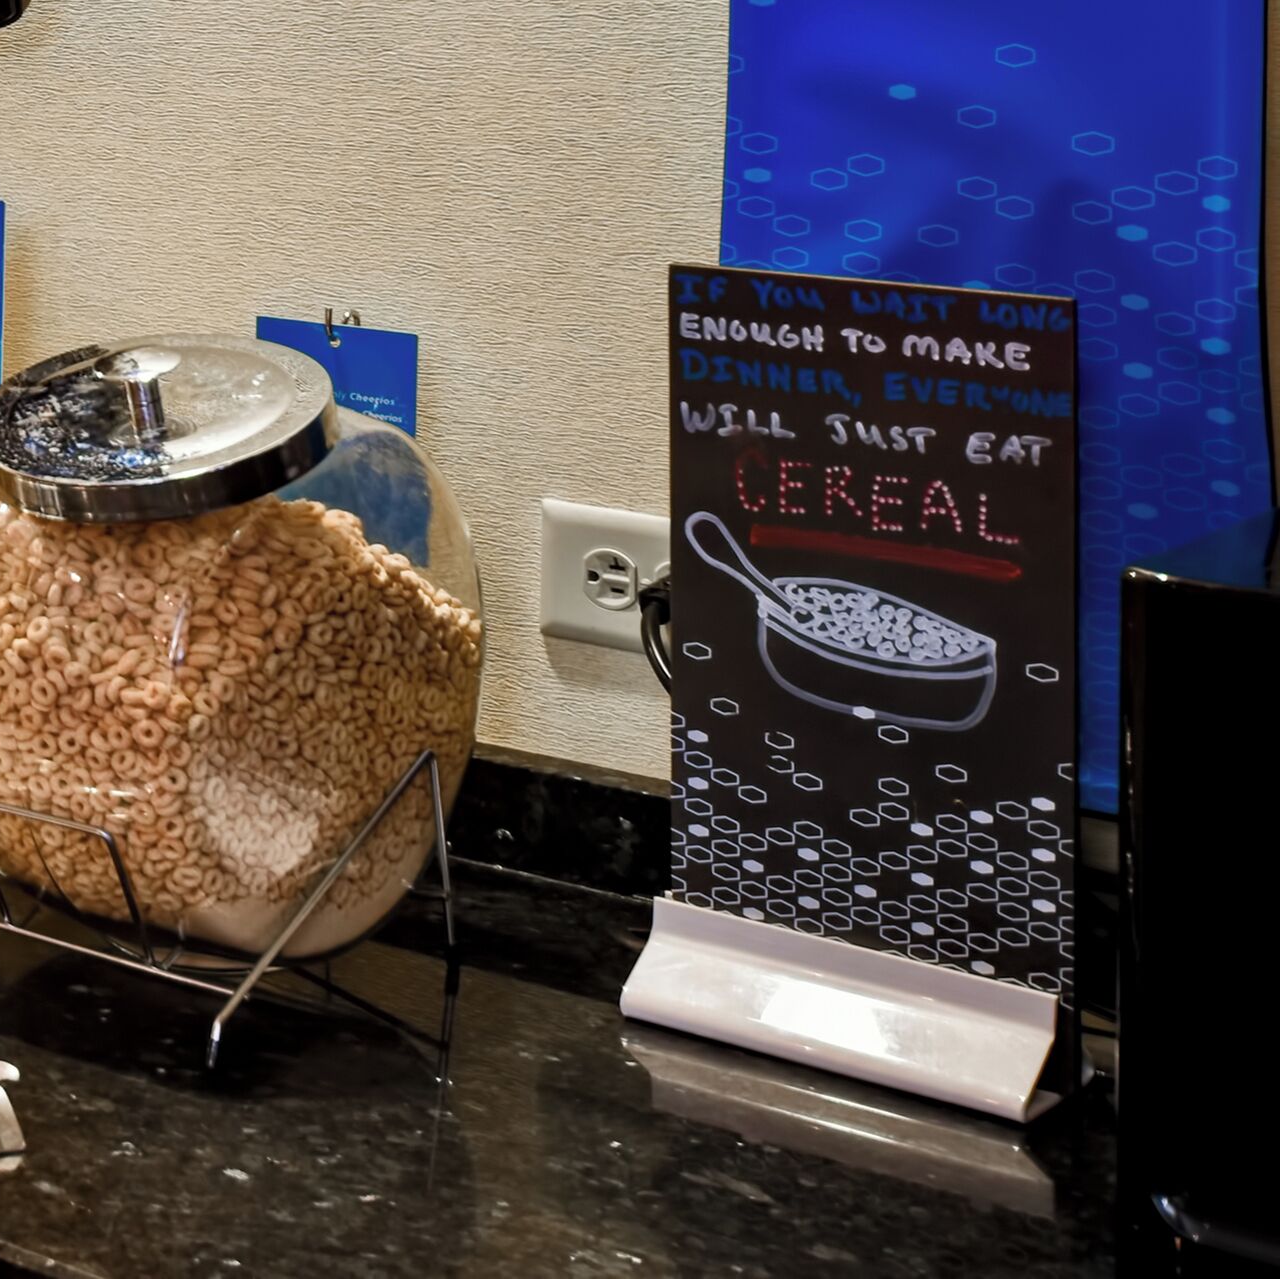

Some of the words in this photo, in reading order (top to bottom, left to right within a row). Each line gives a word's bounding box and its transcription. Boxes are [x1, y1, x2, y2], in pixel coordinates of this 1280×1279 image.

[674, 273, 728, 304] IF
[750, 278, 826, 312] YOU
[851, 290, 956, 324] WAIT
[979, 300, 1073, 332] LONG
[680, 311, 824, 353] ENOUGH
[840, 328, 887, 353] TO
[902, 334, 1031, 371] MAKE
[679, 348, 862, 409] DINNER,
[883, 372, 1073, 418] EVERYONE
[680, 400, 796, 438] WILL
[825, 413, 937, 455] JUST
[966, 431, 1052, 467] EAT
[736, 450, 1020, 543] CEREAL
